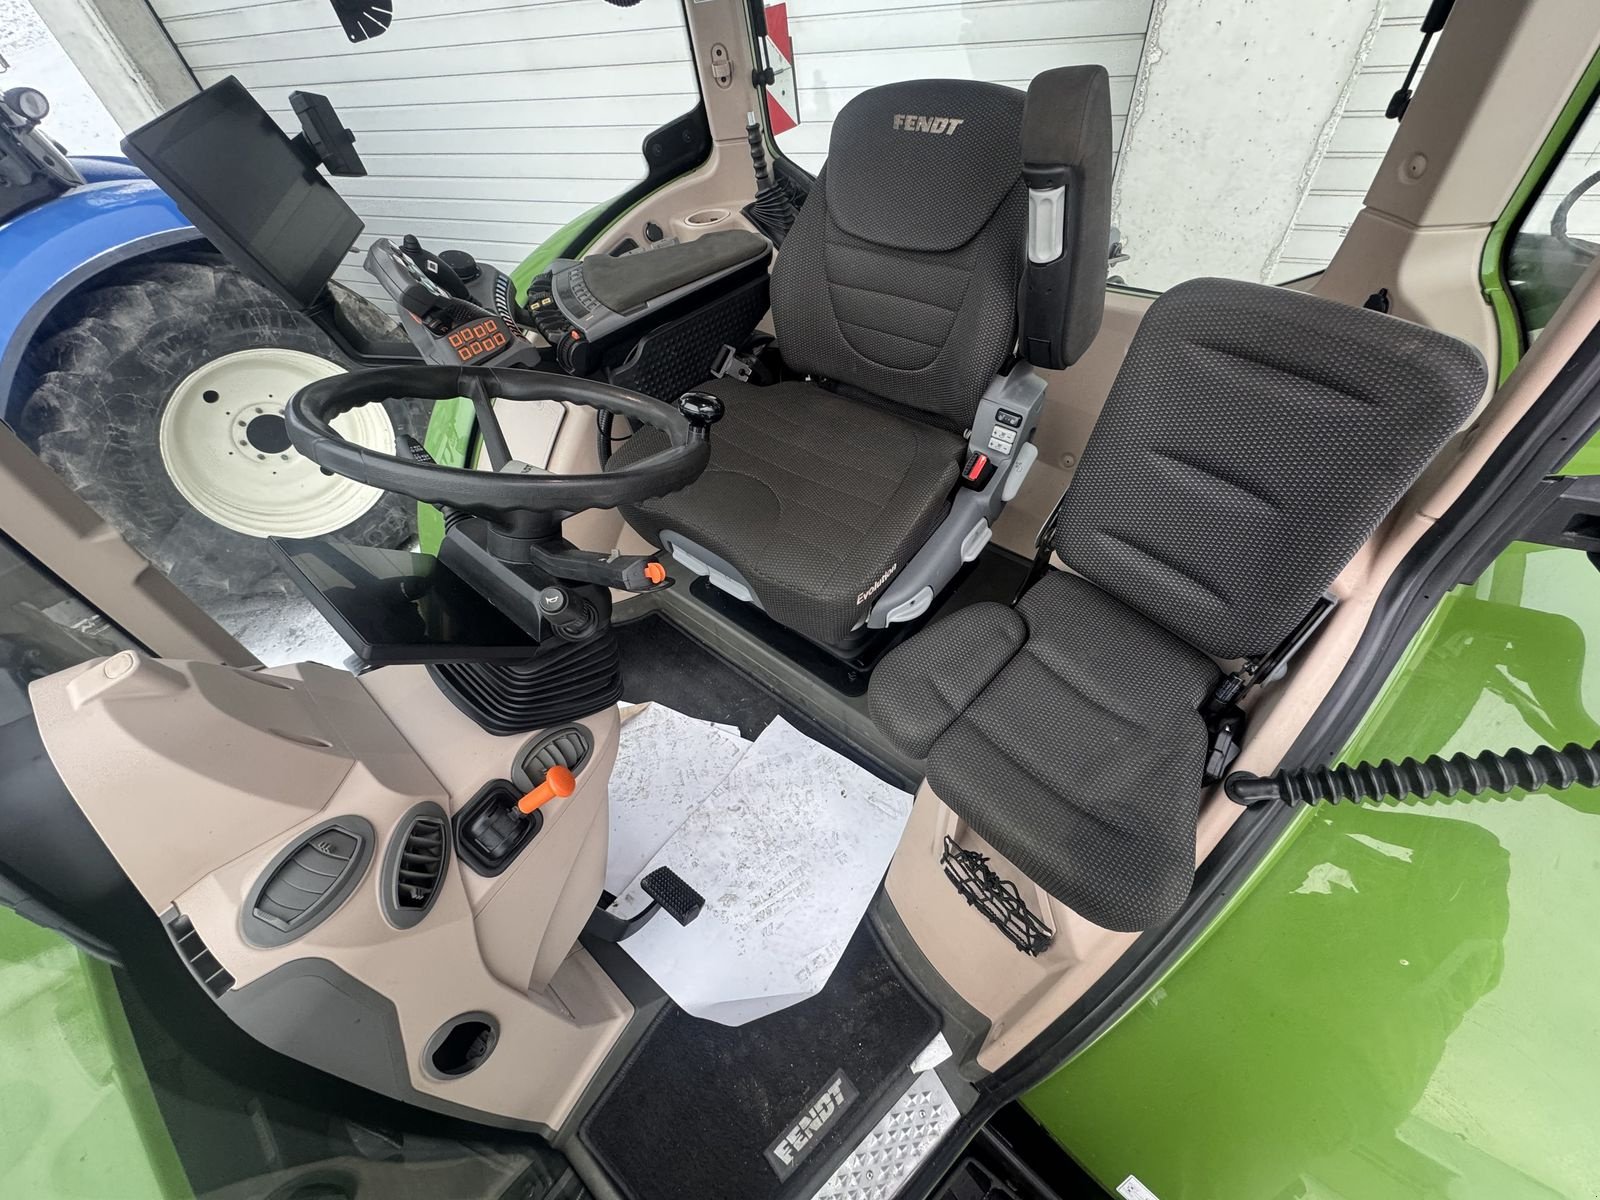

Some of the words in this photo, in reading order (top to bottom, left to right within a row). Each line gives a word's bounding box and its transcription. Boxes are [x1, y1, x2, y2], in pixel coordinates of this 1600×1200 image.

[893, 114, 964, 136] FENDT
[857, 563, 897, 605] Evolution
[774, 1078, 844, 1166] FENDT
